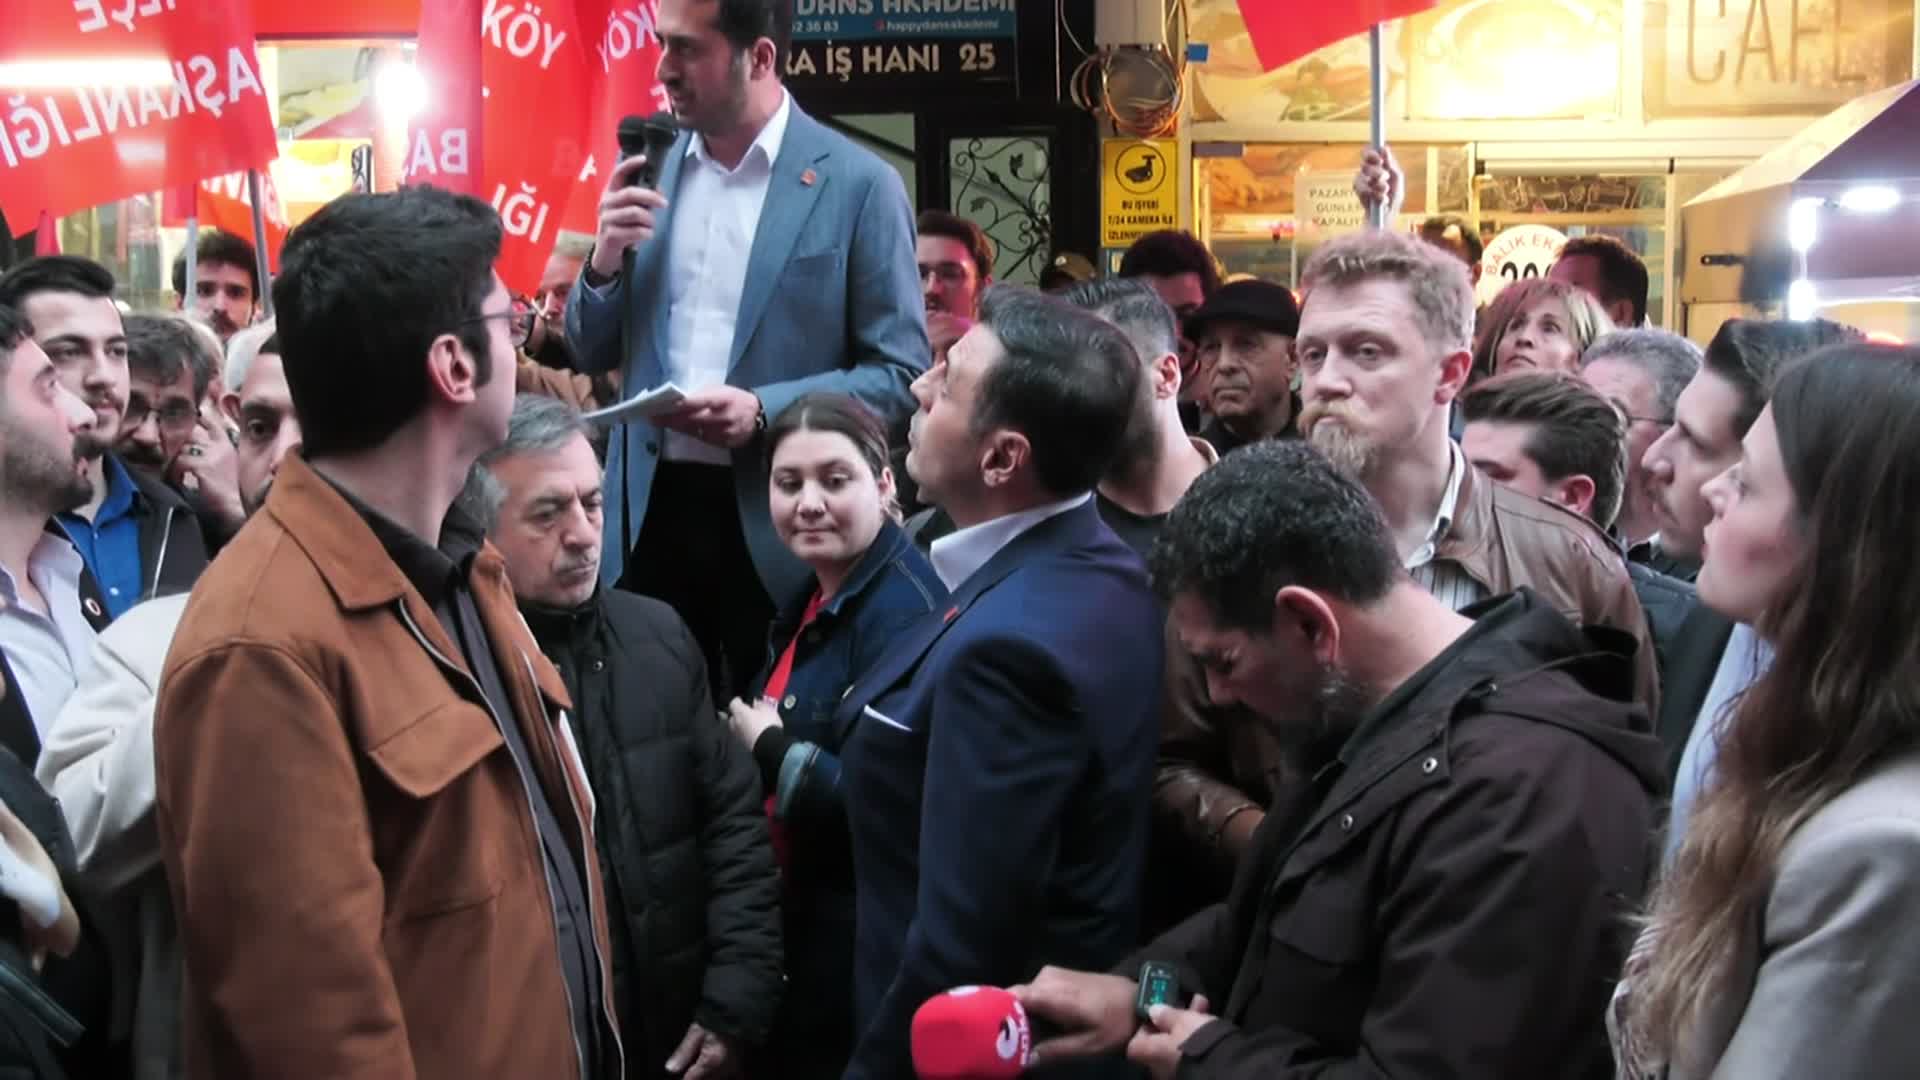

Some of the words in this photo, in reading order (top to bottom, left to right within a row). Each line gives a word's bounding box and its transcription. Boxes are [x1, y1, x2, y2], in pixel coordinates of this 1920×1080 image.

[826, 40, 852, 82] İŞ
[862, 44, 940, 74] HANI
[959, 43, 996, 71] 25
[1122, 199, 1133, 211] BU
[1108, 214, 1125, 226] 7/24
[1127, 214, 1160, 225] KAMERA
[1485, 234, 1526, 274] BALIK
